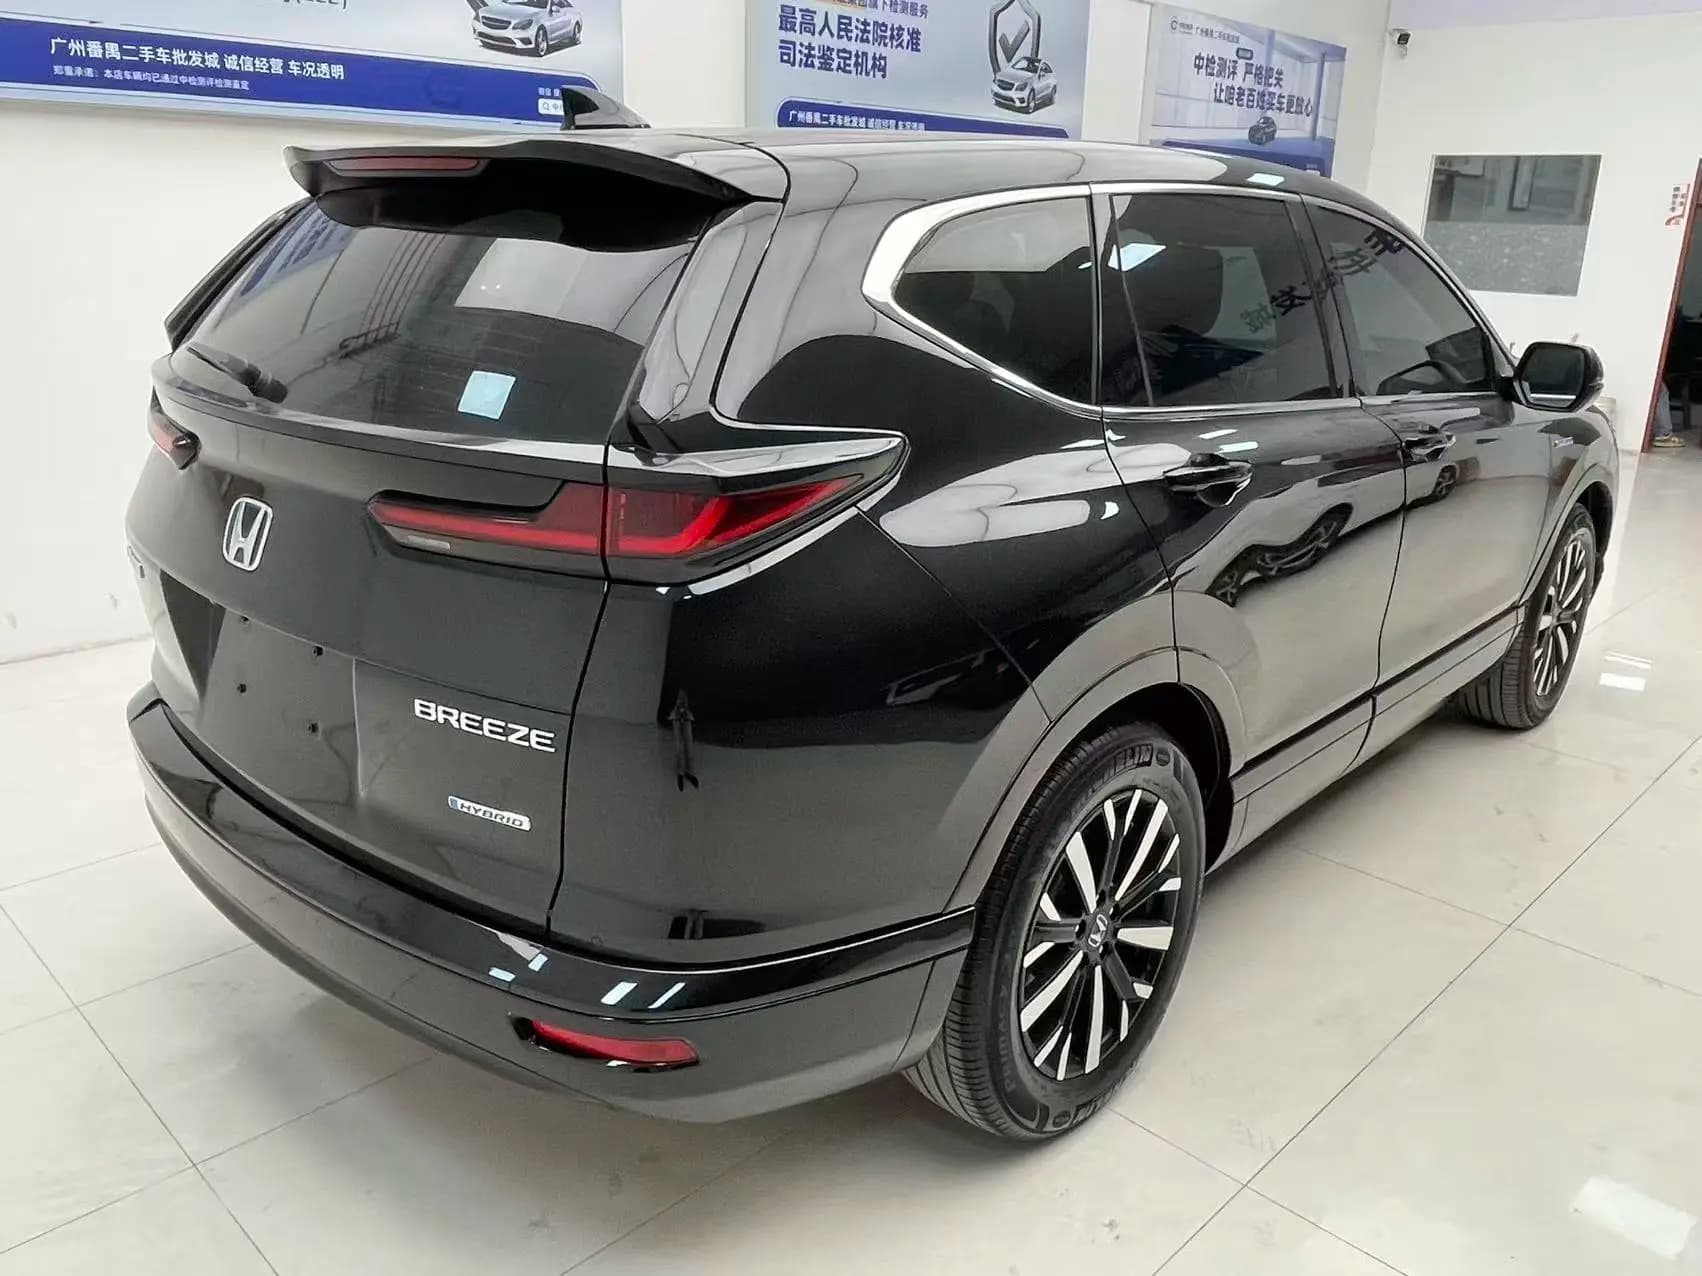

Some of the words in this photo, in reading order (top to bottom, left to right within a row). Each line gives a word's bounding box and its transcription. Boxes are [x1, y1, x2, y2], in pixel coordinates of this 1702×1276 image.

[778, 4, 922, 53] 最高人民法院核准
[50, 37, 220, 69] 广州番禺二手车批发城
[223, 52, 284, 75] 诚信经营
[287, 59, 345, 80] 车况透明
[778, 39, 888, 79] 司法鉴定机构
[1194, 52, 1238, 78] 中检测评
[1242, 62, 1285, 89] 严格把关
[1213, 83, 1313, 117] 让咱老百姓买车更放心
[413, 698, 556, 753] BREEZE
